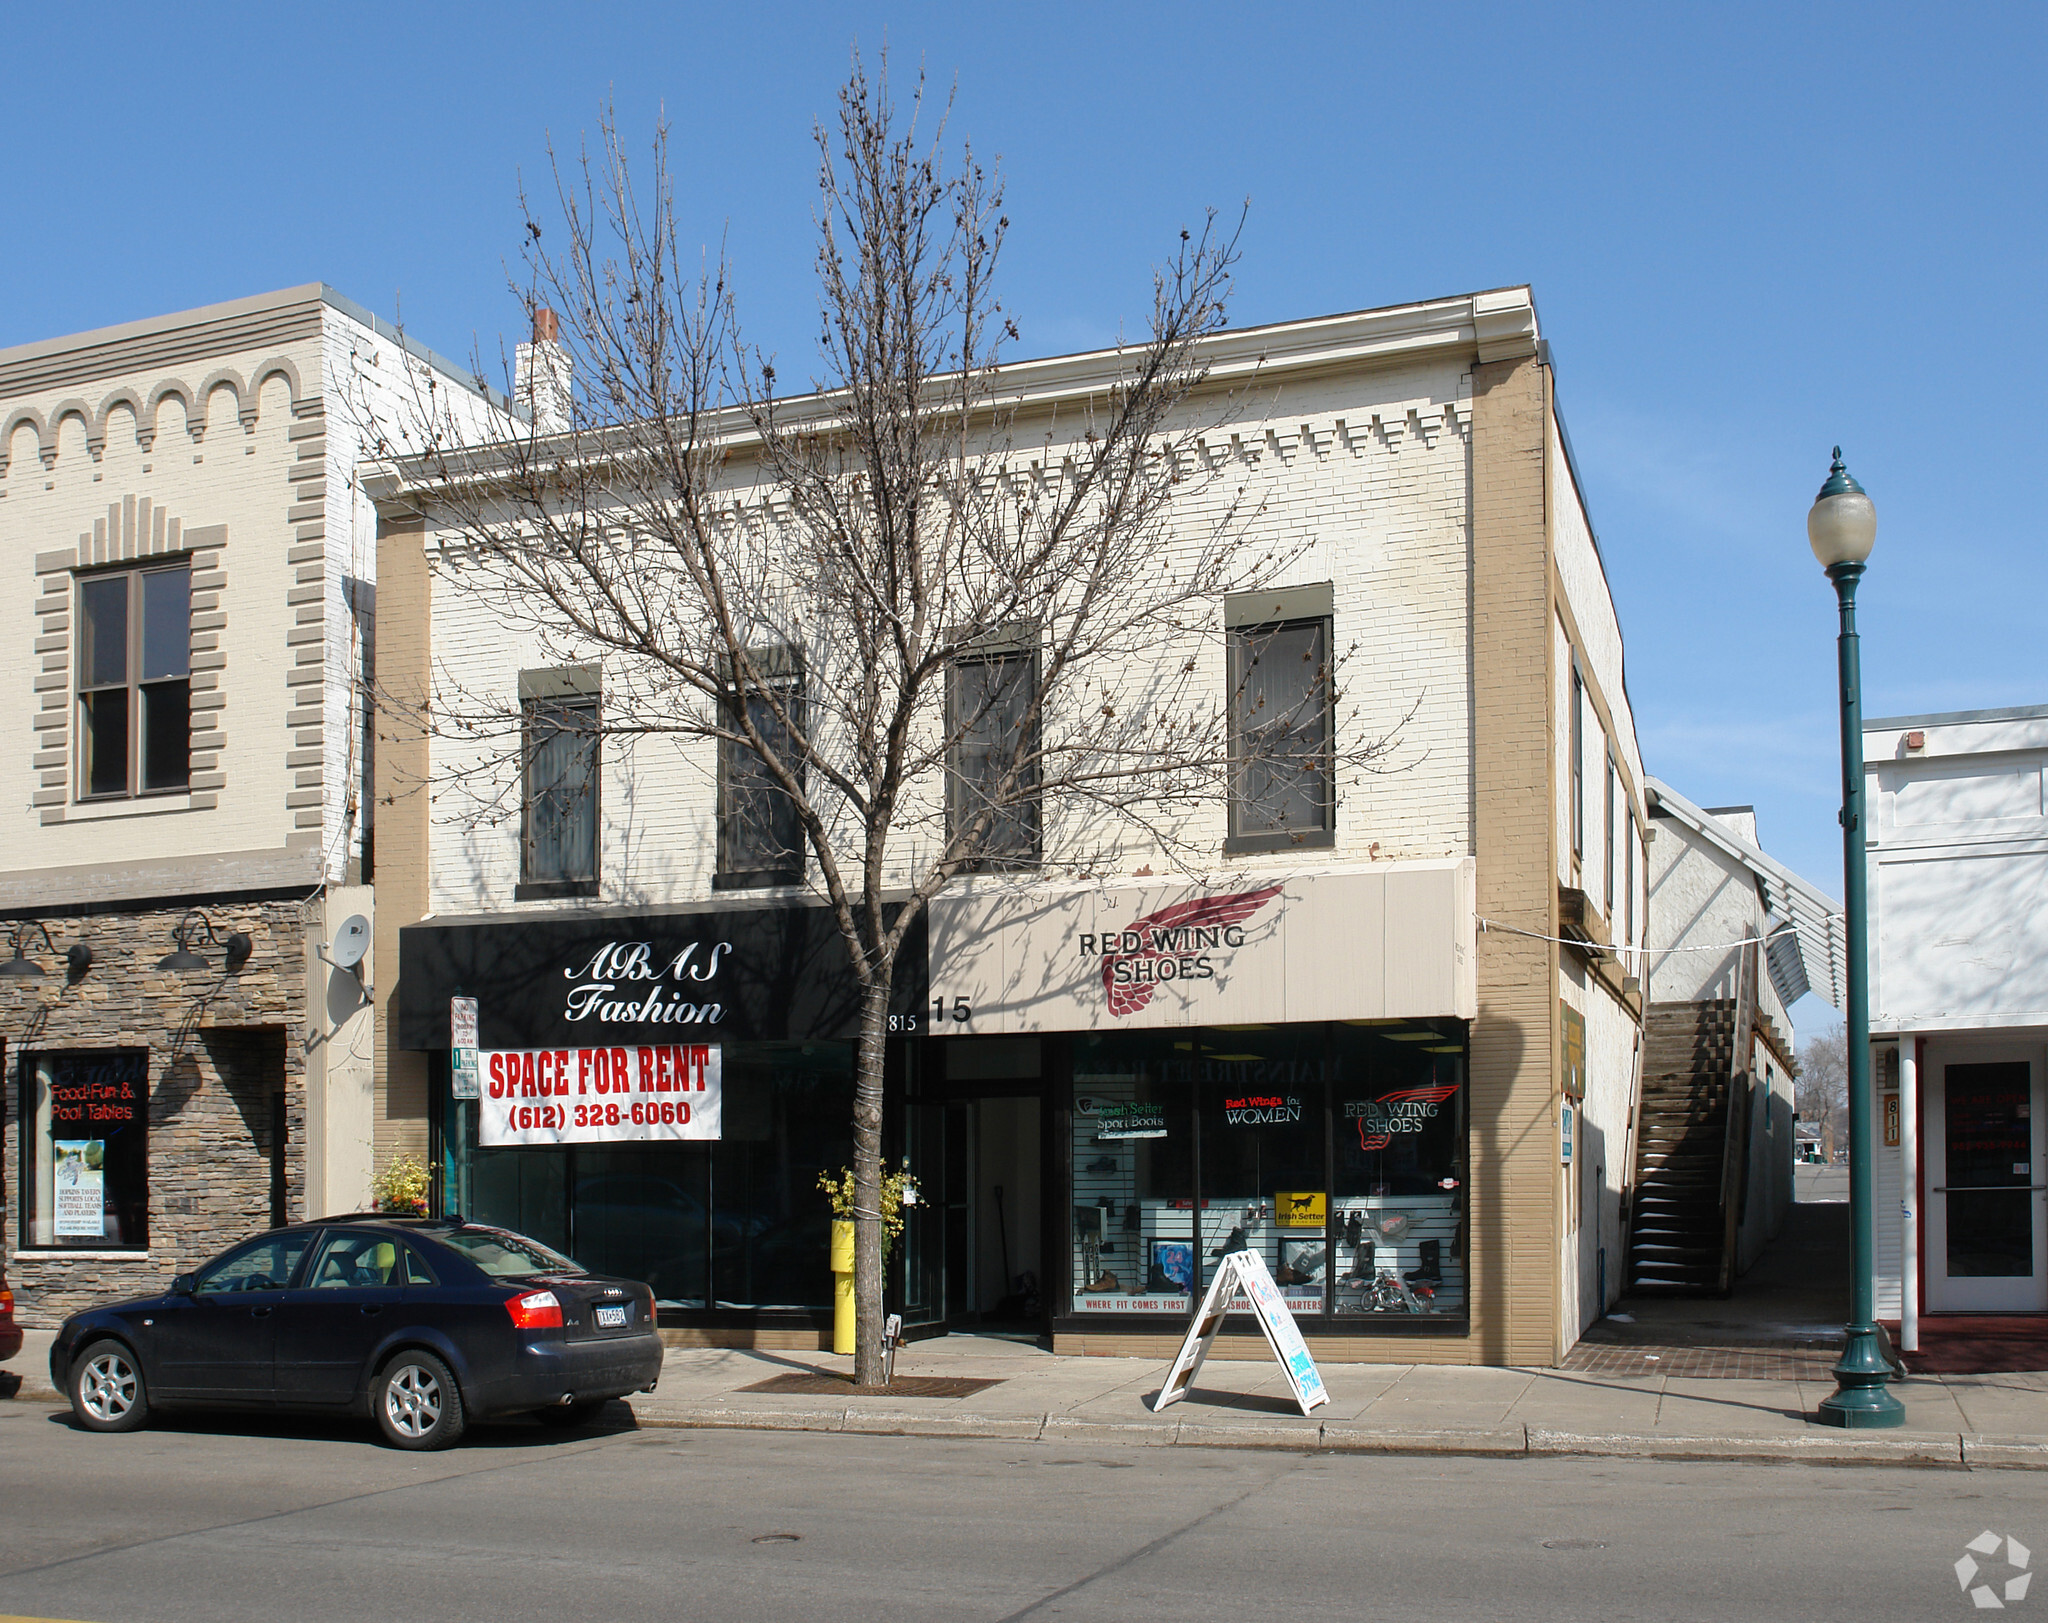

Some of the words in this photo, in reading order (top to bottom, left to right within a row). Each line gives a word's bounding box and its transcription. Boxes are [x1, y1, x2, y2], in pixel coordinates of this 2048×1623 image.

[1078, 931, 1142, 956] RED
[1151, 925, 1245, 952] WING
[1114, 957, 1214, 983] SHOES
[564, 983, 728, 1024] Fashion
[932, 996, 971, 1023] 15
[455, 1013, 475, 1022] PARKING
[888, 1014, 917, 1032] 815
[489, 1049, 569, 1099] SPACE
[578, 1047, 630, 1095] FOR
[637, 1044, 709, 1092] RENT
[120, 1082, 134, 1099] &
[51, 1104, 82, 1120] Pool
[86, 1103, 134, 1120] Tables
[1130, 1102, 1162, 1114] Setter
[1225, 1098, 1246, 1109] Red
[1344, 1103, 1379, 1118] RED
[1386, 1102, 1439, 1117] WING
[509, 1103, 565, 1132] (612)
[574, 1101, 691, 1127] 328-6060
[1098, 1116, 1128, 1131] Sport
[1131, 1115, 1164, 1127] Boots
[1225, 1106, 1302, 1125] WOMEN
[1889, 1101, 1897, 1140] 811
[1366, 1118, 1423, 1133] SHOES
[1278, 1212, 1297, 1220] Irish
[1298, 1212, 1325, 1220] Setter
[1166, 1251, 1183, 1264] 24
[1171, 1266, 1179, 1277] 7
[1085, 1300, 1111, 1309] WHERE
[1116, 1300, 1128, 1309] FIT
[1132, 1300, 1158, 1309] COMES
[1163, 1300, 1185, 1309] FIRST
